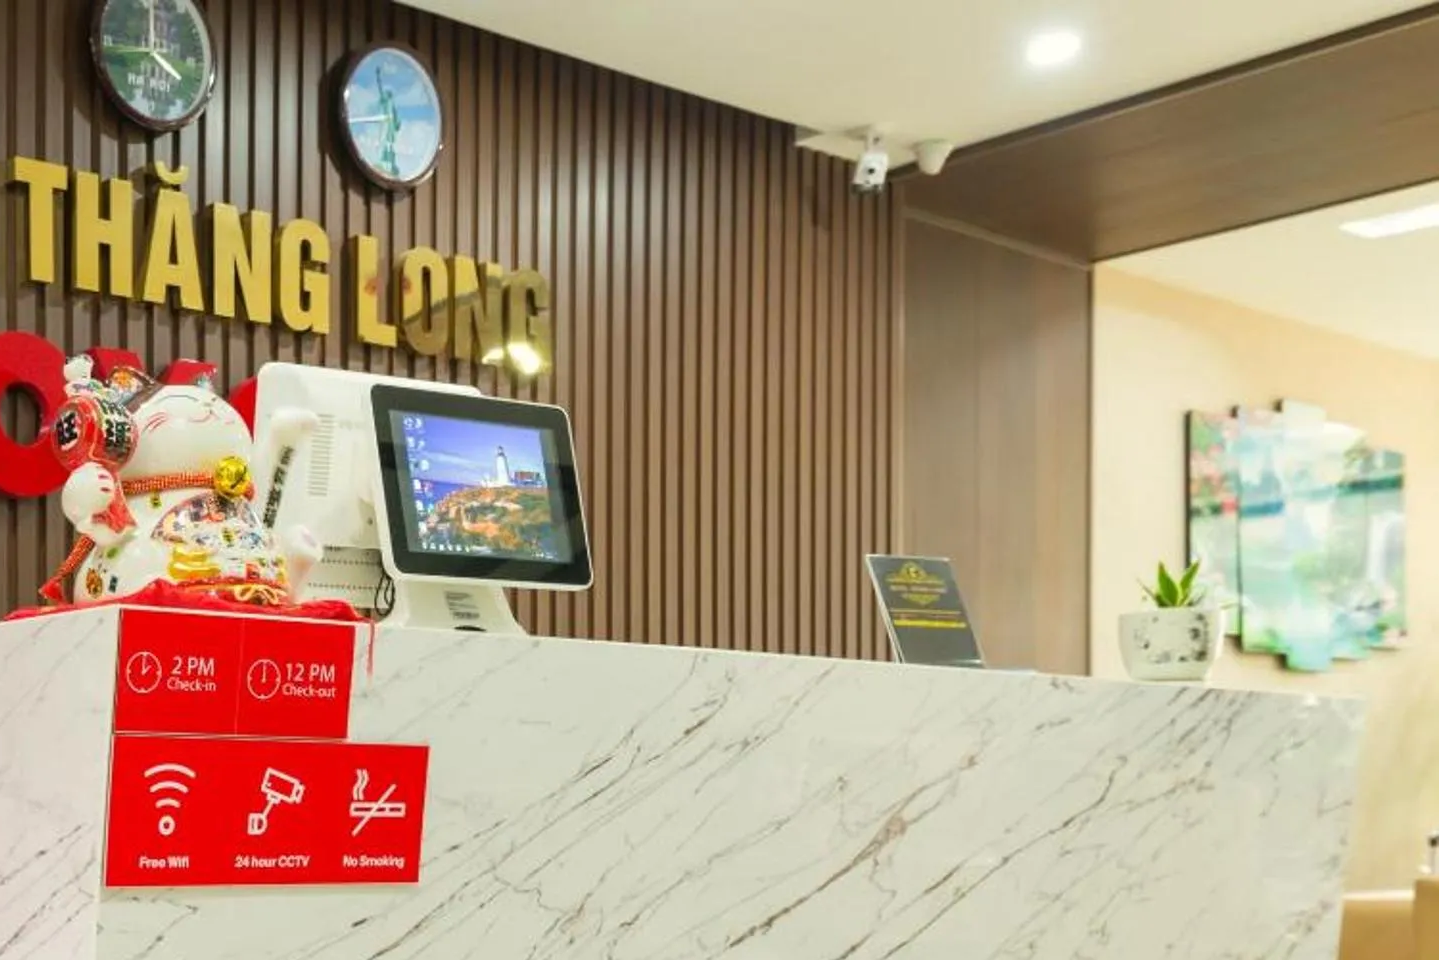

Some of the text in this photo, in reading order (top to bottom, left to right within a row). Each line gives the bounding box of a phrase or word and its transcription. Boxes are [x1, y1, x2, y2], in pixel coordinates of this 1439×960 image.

[12, 158, 331, 335] THĂNG
[357, 234, 551, 375] LONG
[171, 655, 215, 677] 2 PM
[285, 662, 336, 684] 12 PM
[166, 676, 217, 692] Check-in
[282, 682, 337, 699] Check-out
[138, 855, 166, 869] Free
[234, 854, 311, 869] 24 hour CCTV
[342, 854, 405, 870] No Smoking
